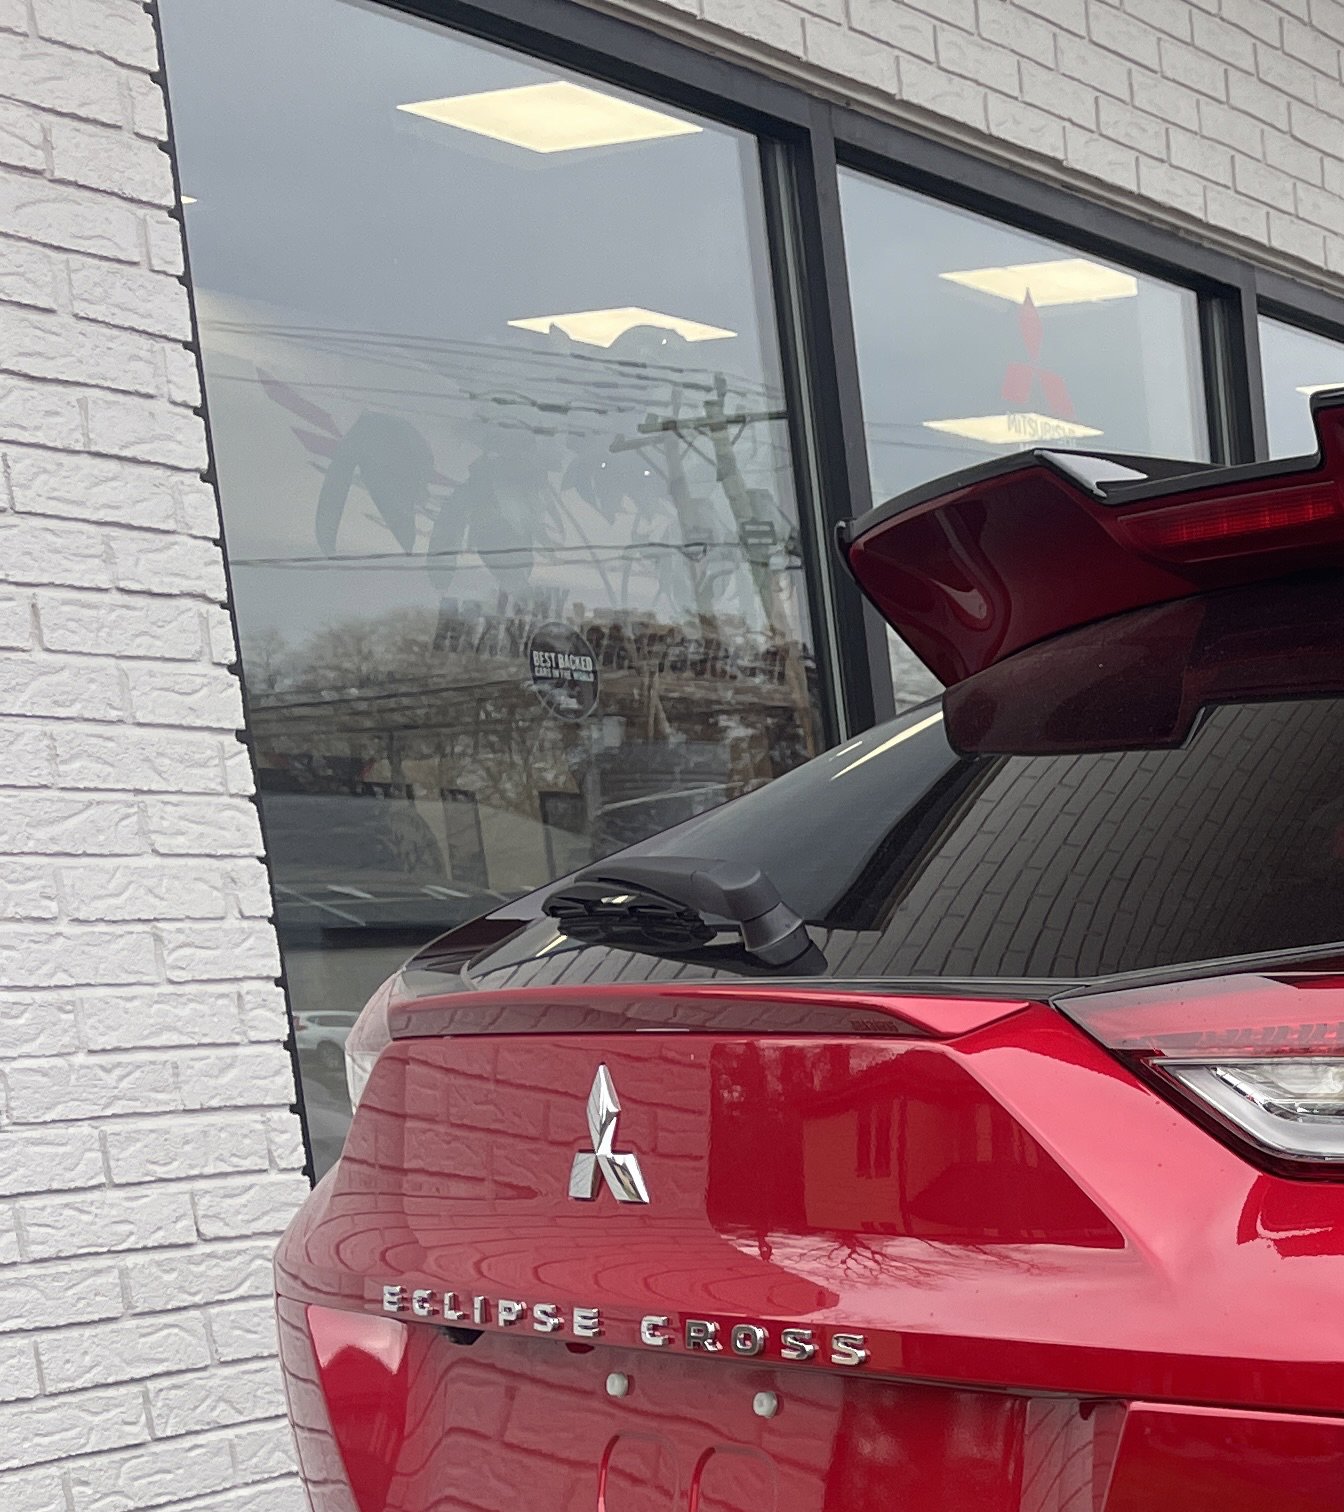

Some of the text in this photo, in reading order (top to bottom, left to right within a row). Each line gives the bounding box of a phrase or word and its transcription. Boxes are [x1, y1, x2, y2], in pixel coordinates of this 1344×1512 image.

[532, 650, 593, 671] BEST BACKED
[382, 1284, 870, 1367] ECLIPSE CROSS
